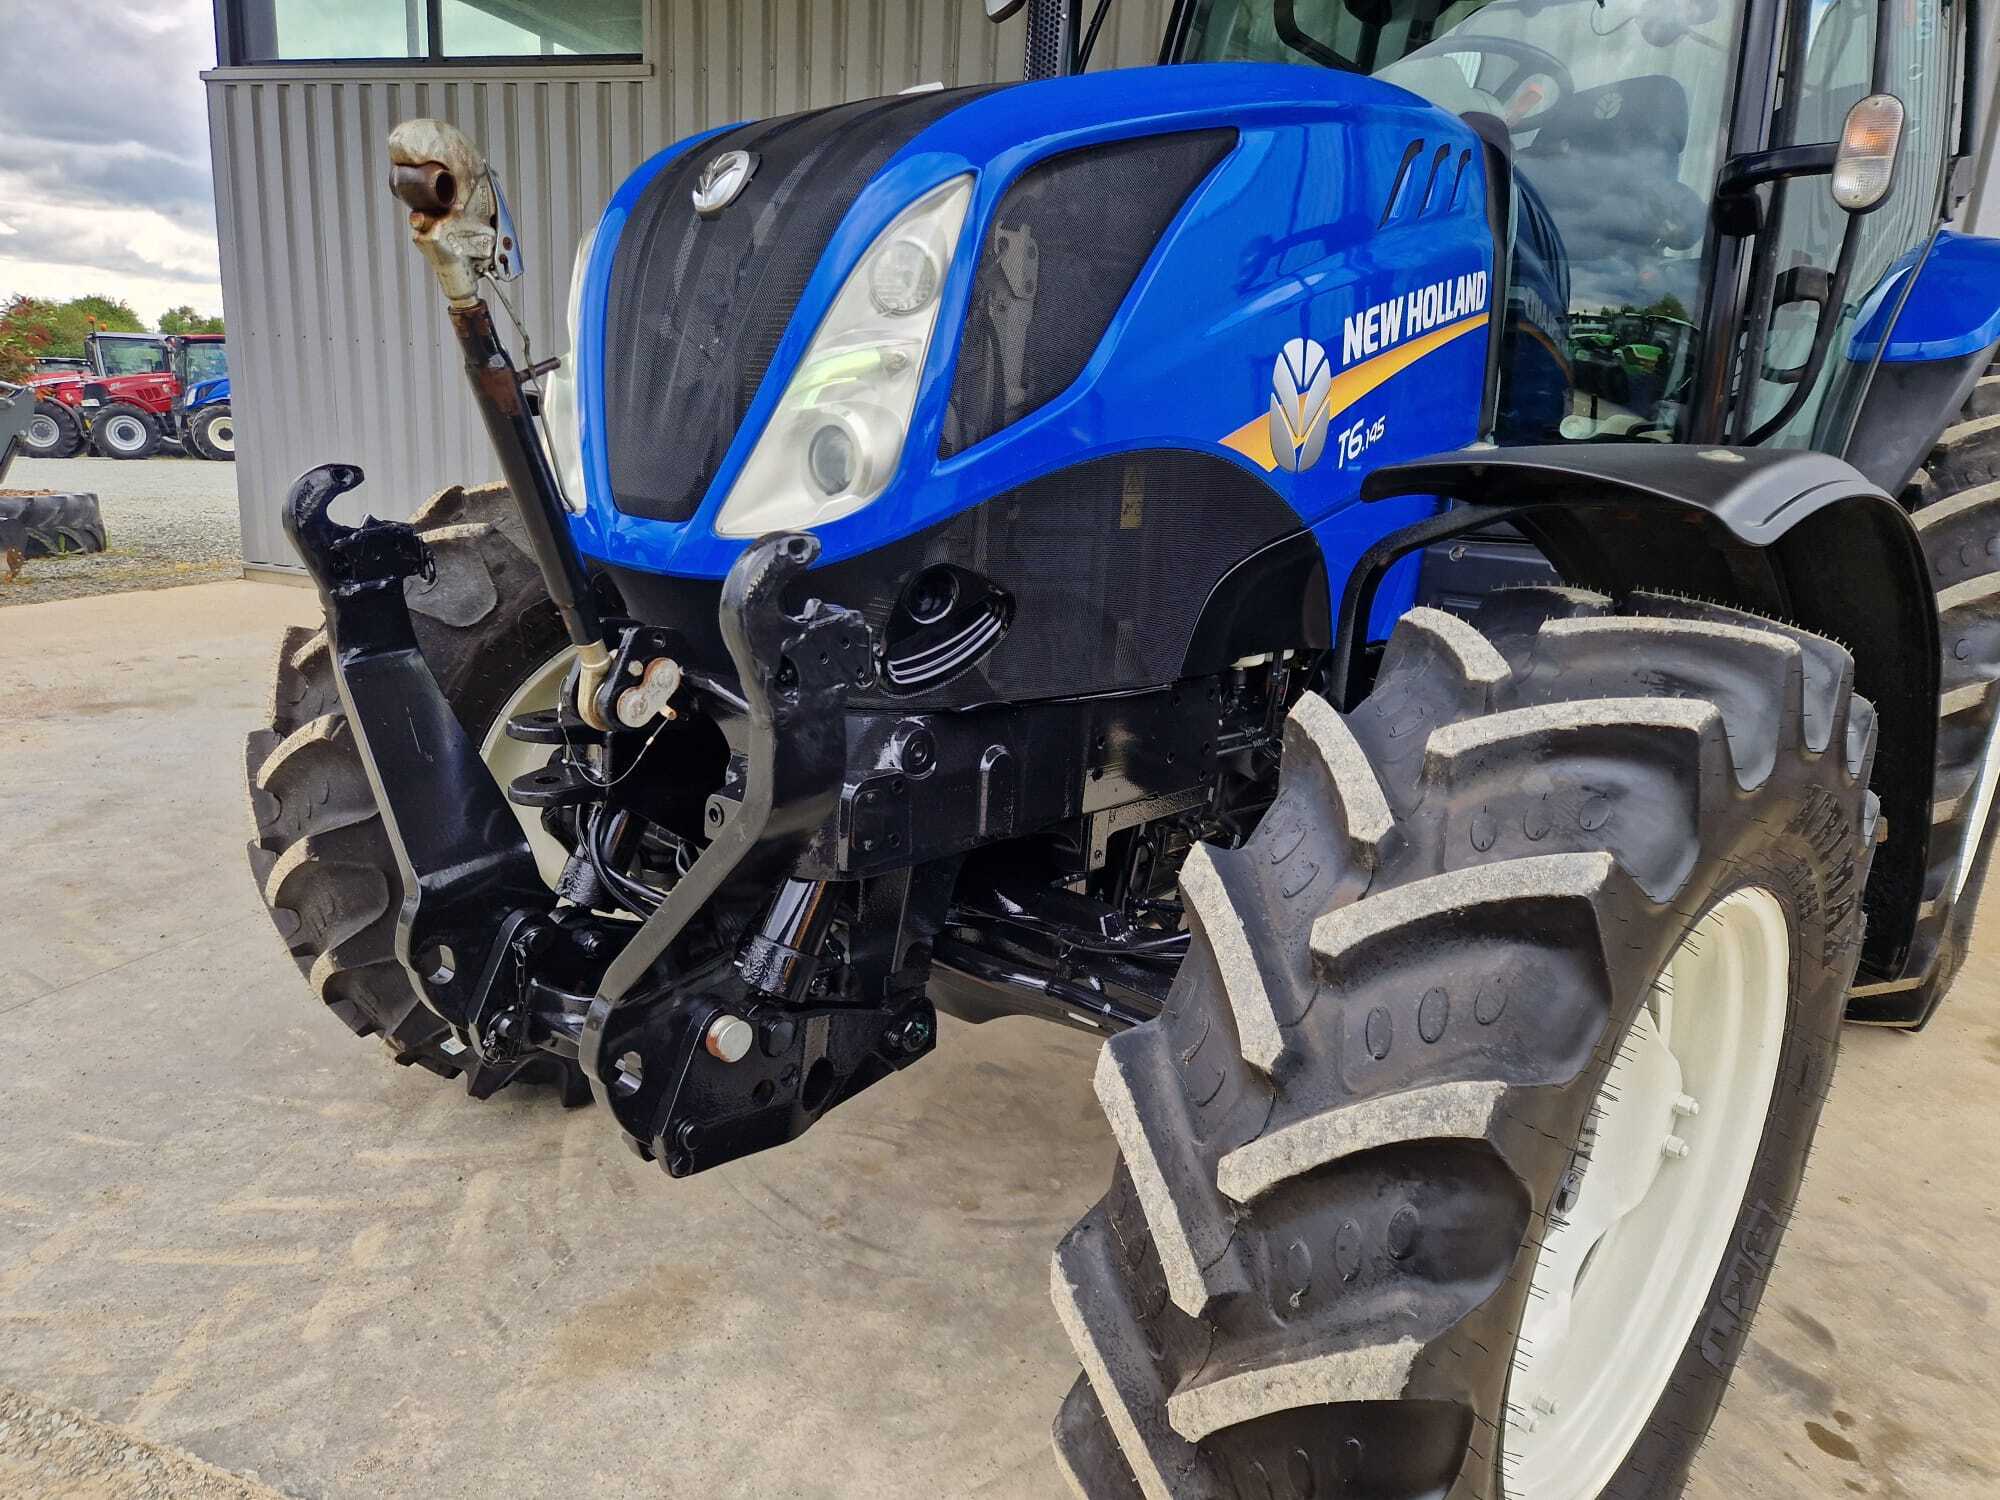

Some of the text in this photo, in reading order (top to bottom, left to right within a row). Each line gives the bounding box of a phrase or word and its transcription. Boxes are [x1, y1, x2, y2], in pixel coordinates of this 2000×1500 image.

[1342, 295, 1404, 367] NEW
[1406, 270, 1487, 337] HOLLAND
[1338, 414, 1386, 469] T6.145
